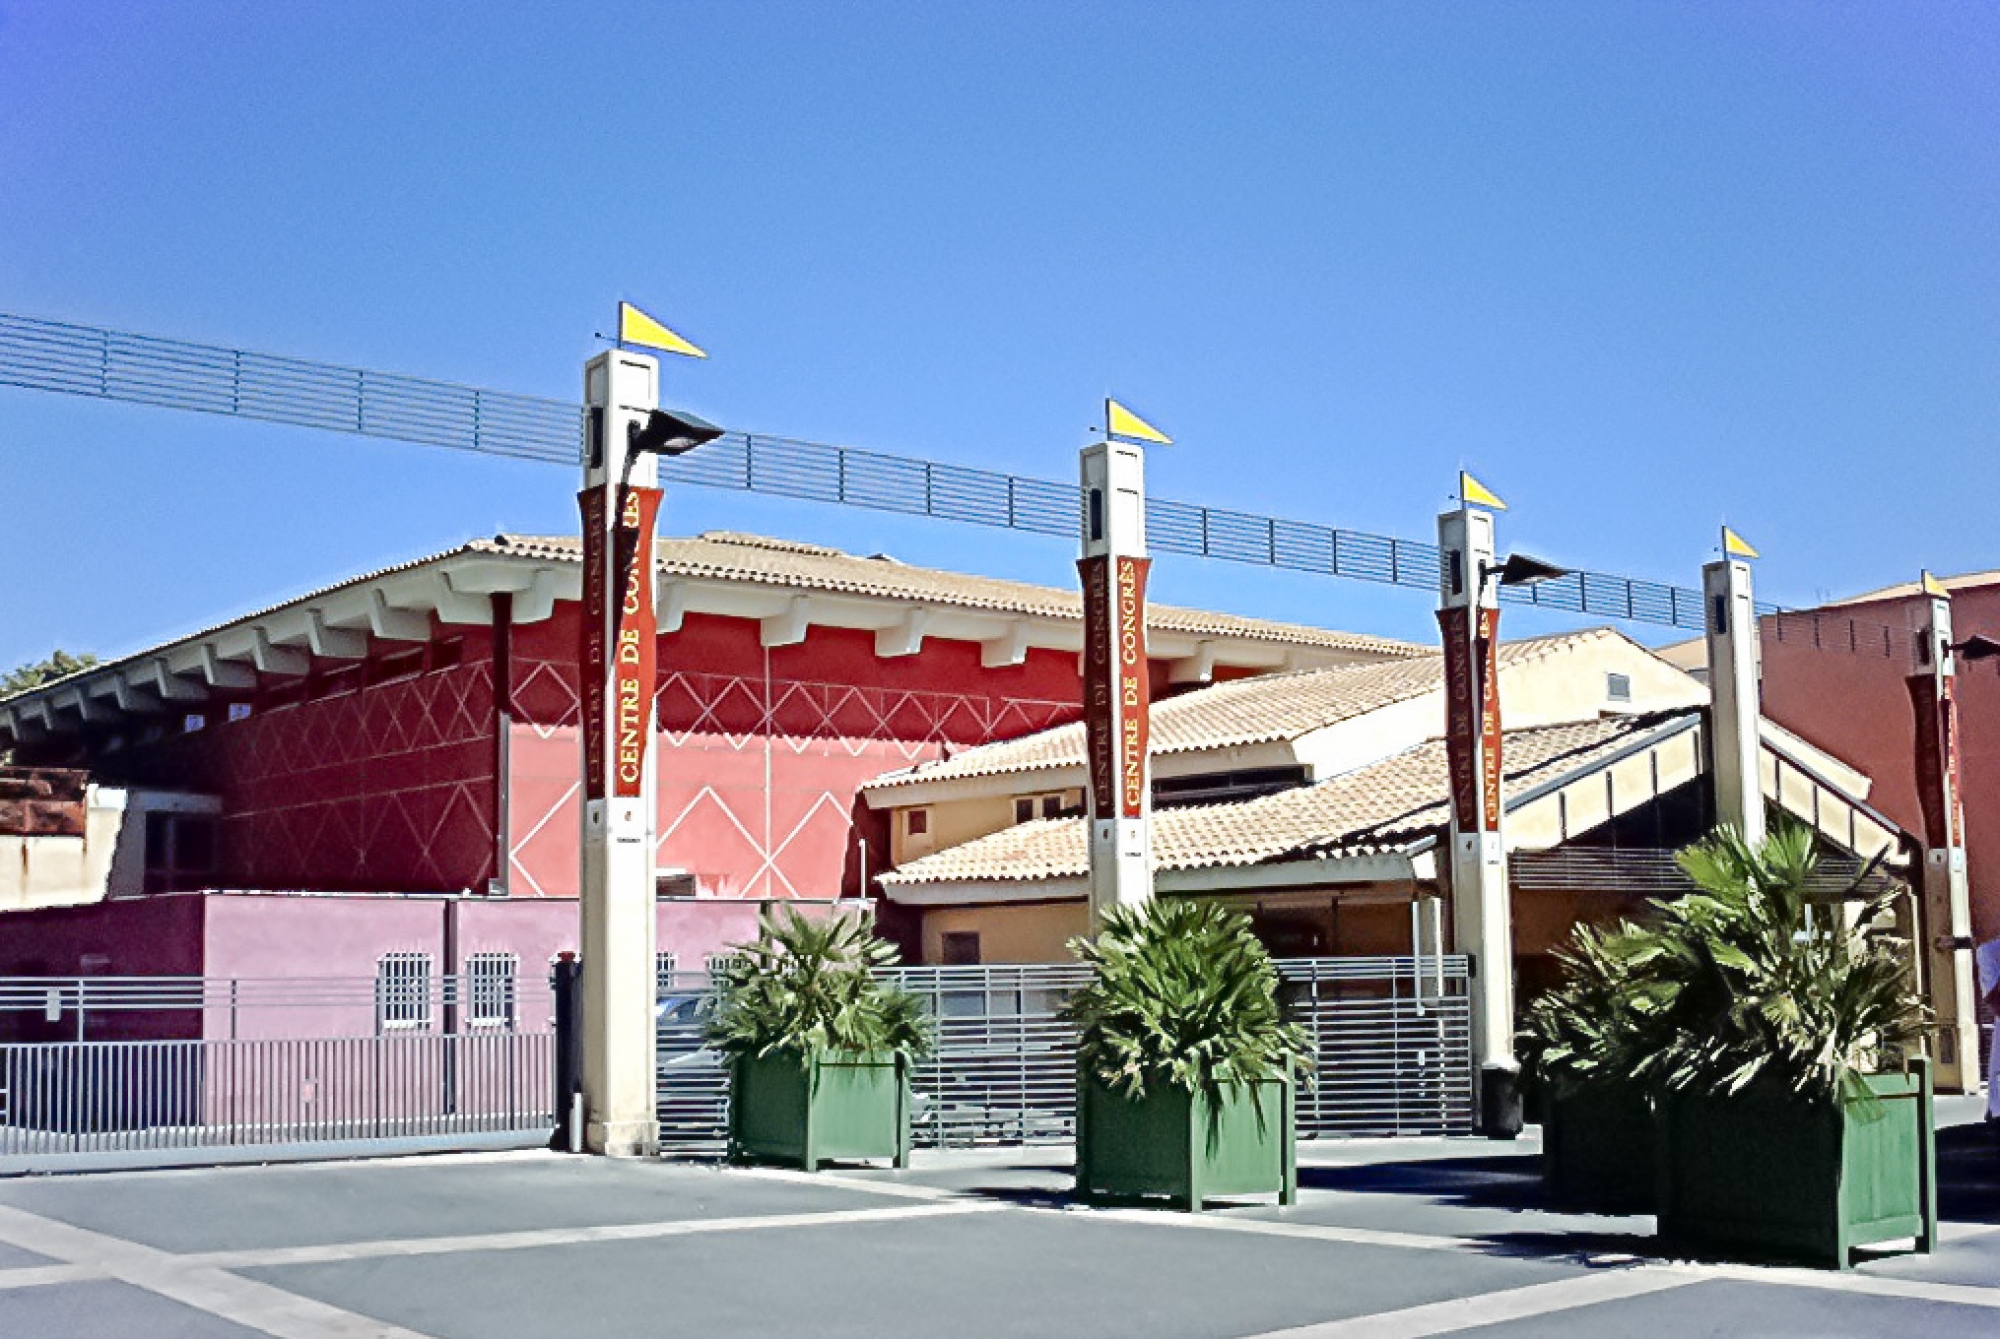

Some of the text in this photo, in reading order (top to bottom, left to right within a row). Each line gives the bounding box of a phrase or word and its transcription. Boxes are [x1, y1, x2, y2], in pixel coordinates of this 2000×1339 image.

[620, 629, 640, 664] DE
[1123, 677, 1138, 706] DE
[620, 678, 640, 783] CENTRE
[1482, 712, 1494, 735] DE
[1125, 719, 1139, 806] CENTRE
[1484, 748, 1497, 821] CENTRE
